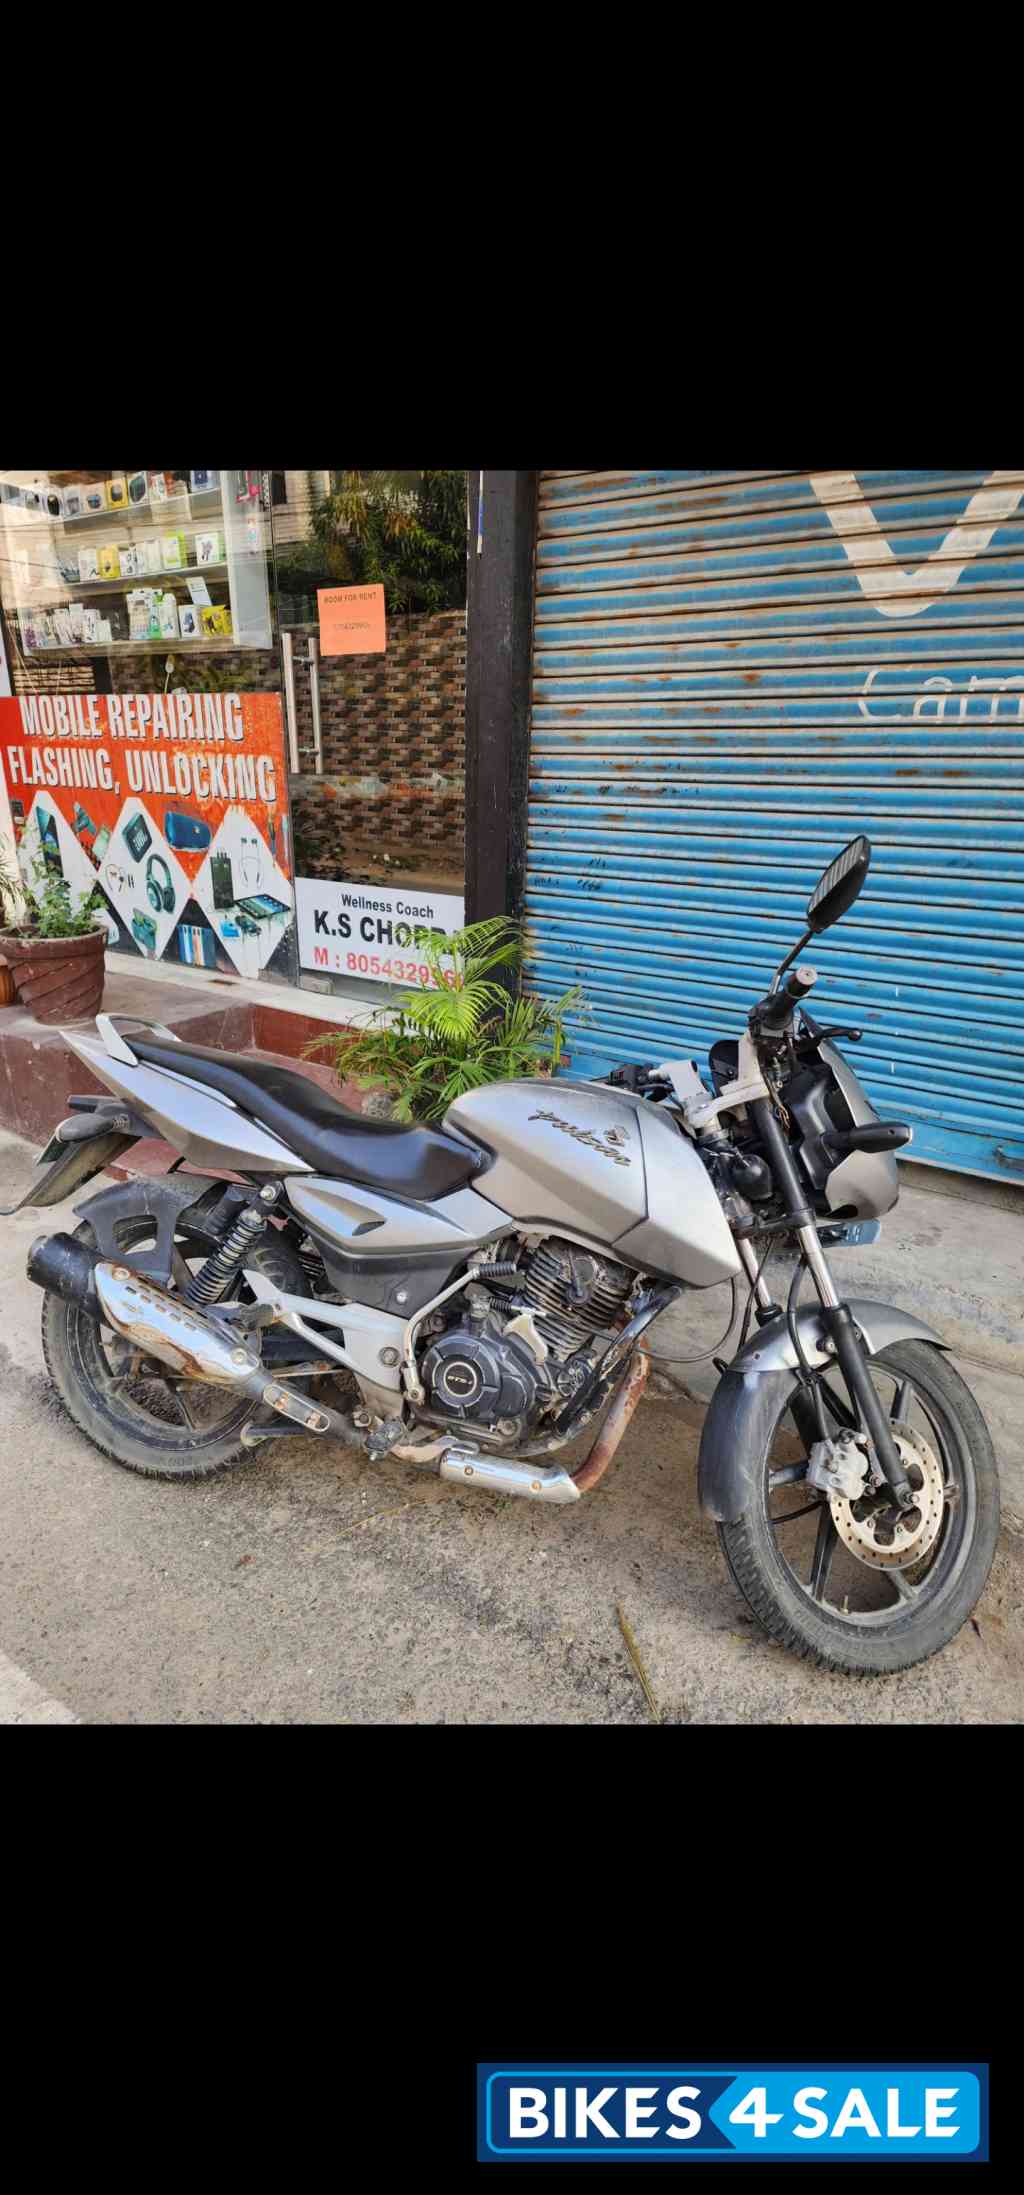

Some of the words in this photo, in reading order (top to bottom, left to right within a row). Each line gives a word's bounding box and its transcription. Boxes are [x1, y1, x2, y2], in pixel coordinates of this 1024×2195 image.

[19, 695, 103, 737] MOBILE
[107, 693, 244, 741] REPAIRING
[7, 745, 121, 795] FLASHING,
[125, 749, 277, 802] UNLOCKING
[341, 893, 392, 913] Wellness
[396, 901, 434, 919] Coach
[314, 909, 351, 938] K.S
[314, 947, 329, 965] M
